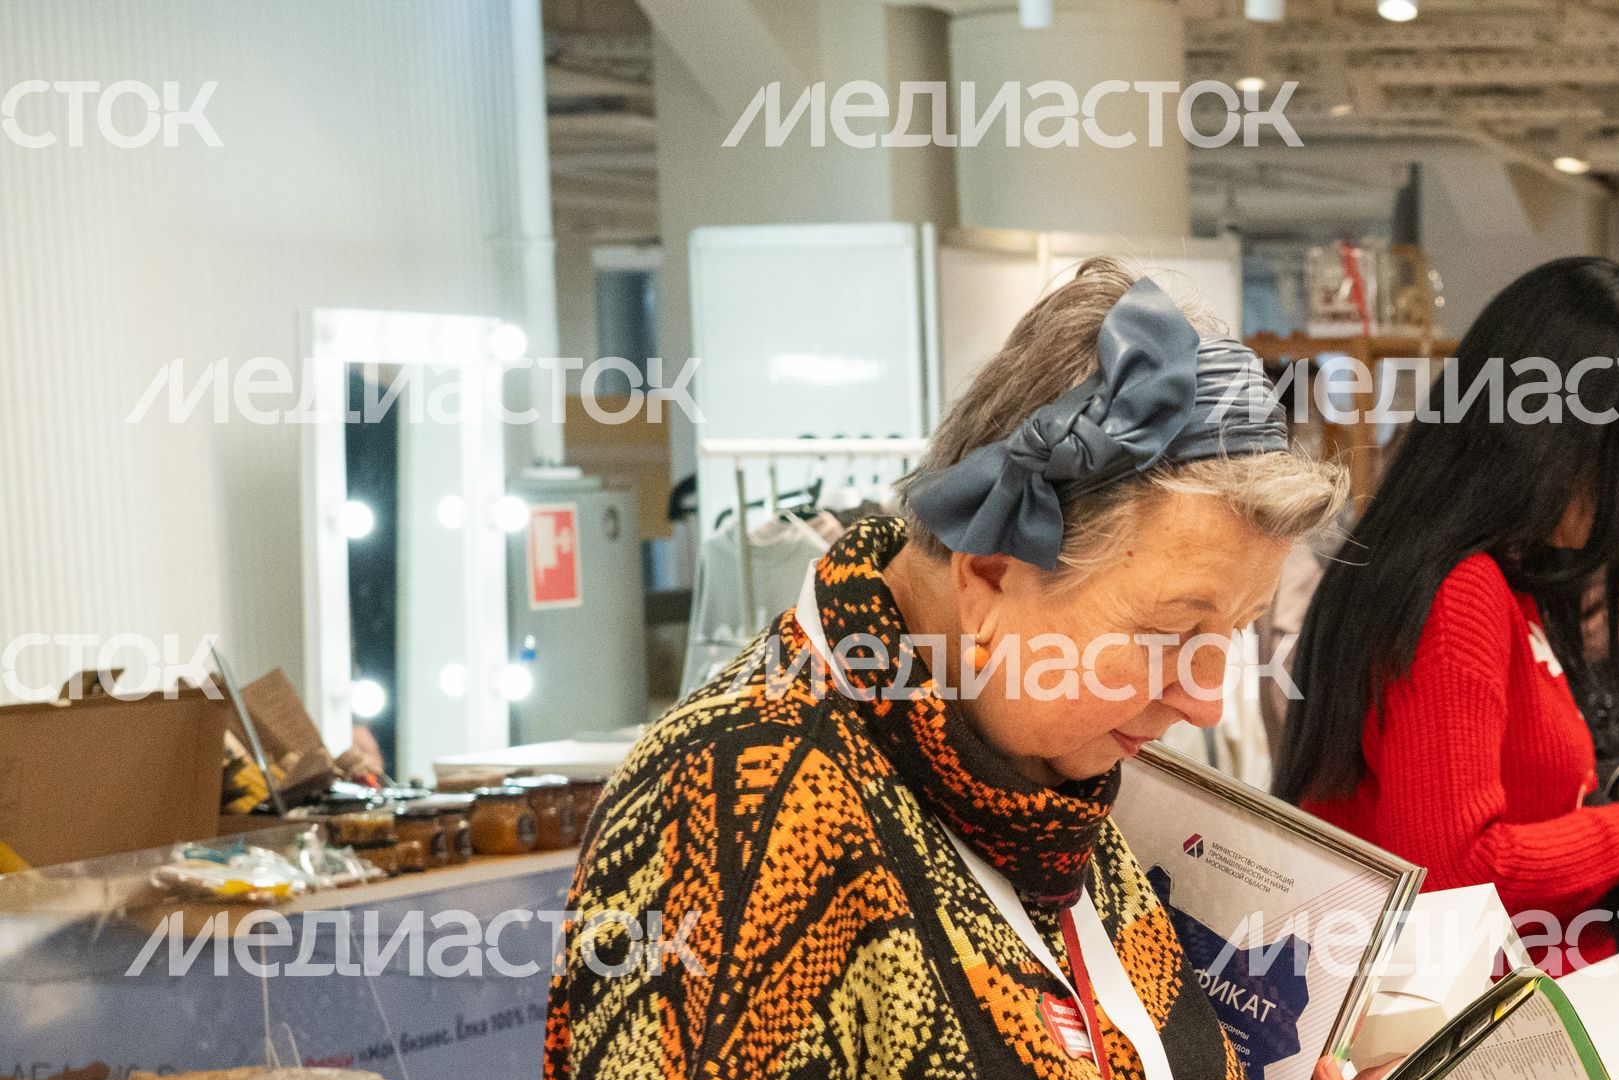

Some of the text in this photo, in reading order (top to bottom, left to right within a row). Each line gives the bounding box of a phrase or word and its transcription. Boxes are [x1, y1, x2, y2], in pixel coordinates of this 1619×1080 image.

[1208, 849, 1264, 881] ПРОМЫШЛЕННОСТИ
[1270, 880, 1290, 894] НАУКИ
[1212, 842, 1256, 867] МИНИСТЕРСТВО
[1205, 857, 1271, 894] МОСКОВСКОЙ ОБЛАСТИ
